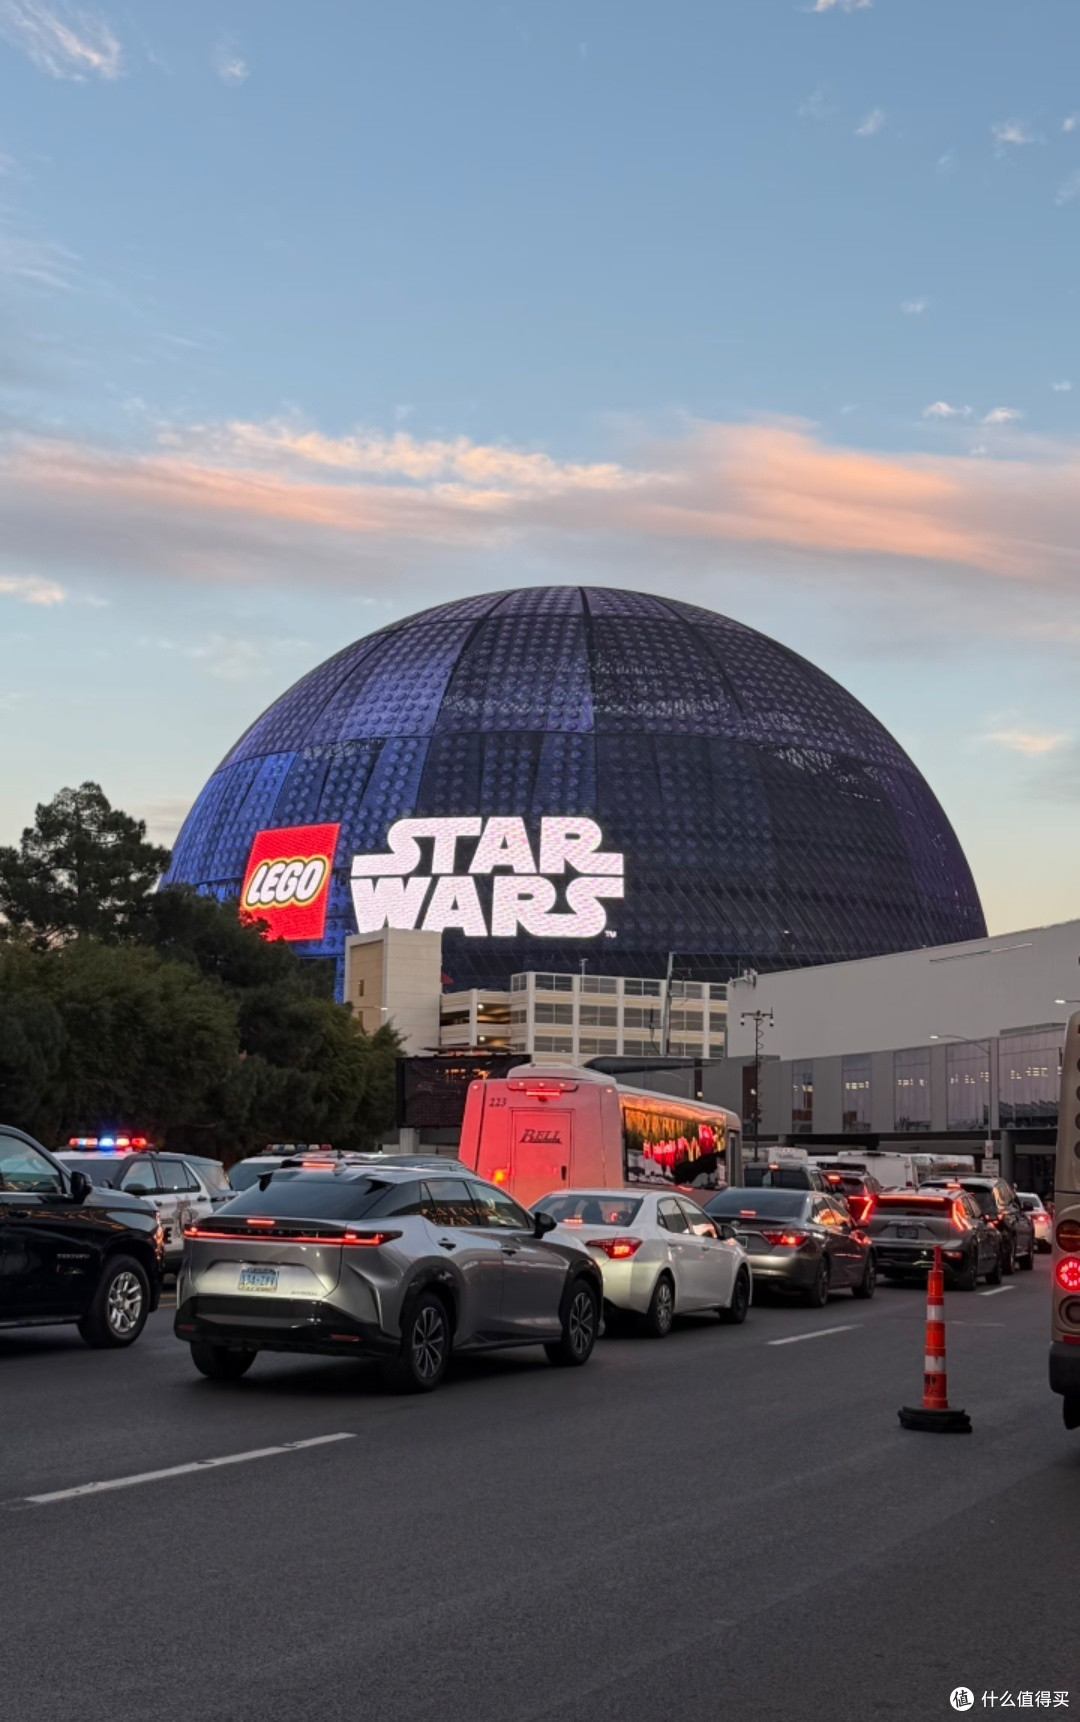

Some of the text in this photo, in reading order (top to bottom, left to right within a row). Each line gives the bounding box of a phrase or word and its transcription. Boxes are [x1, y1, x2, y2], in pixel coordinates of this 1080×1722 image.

[351, 816, 624, 876] STAR
[245, 859, 326, 906] LEGO
[350, 876, 624, 938] WARS
[489, 1097, 507, 1108] 223
